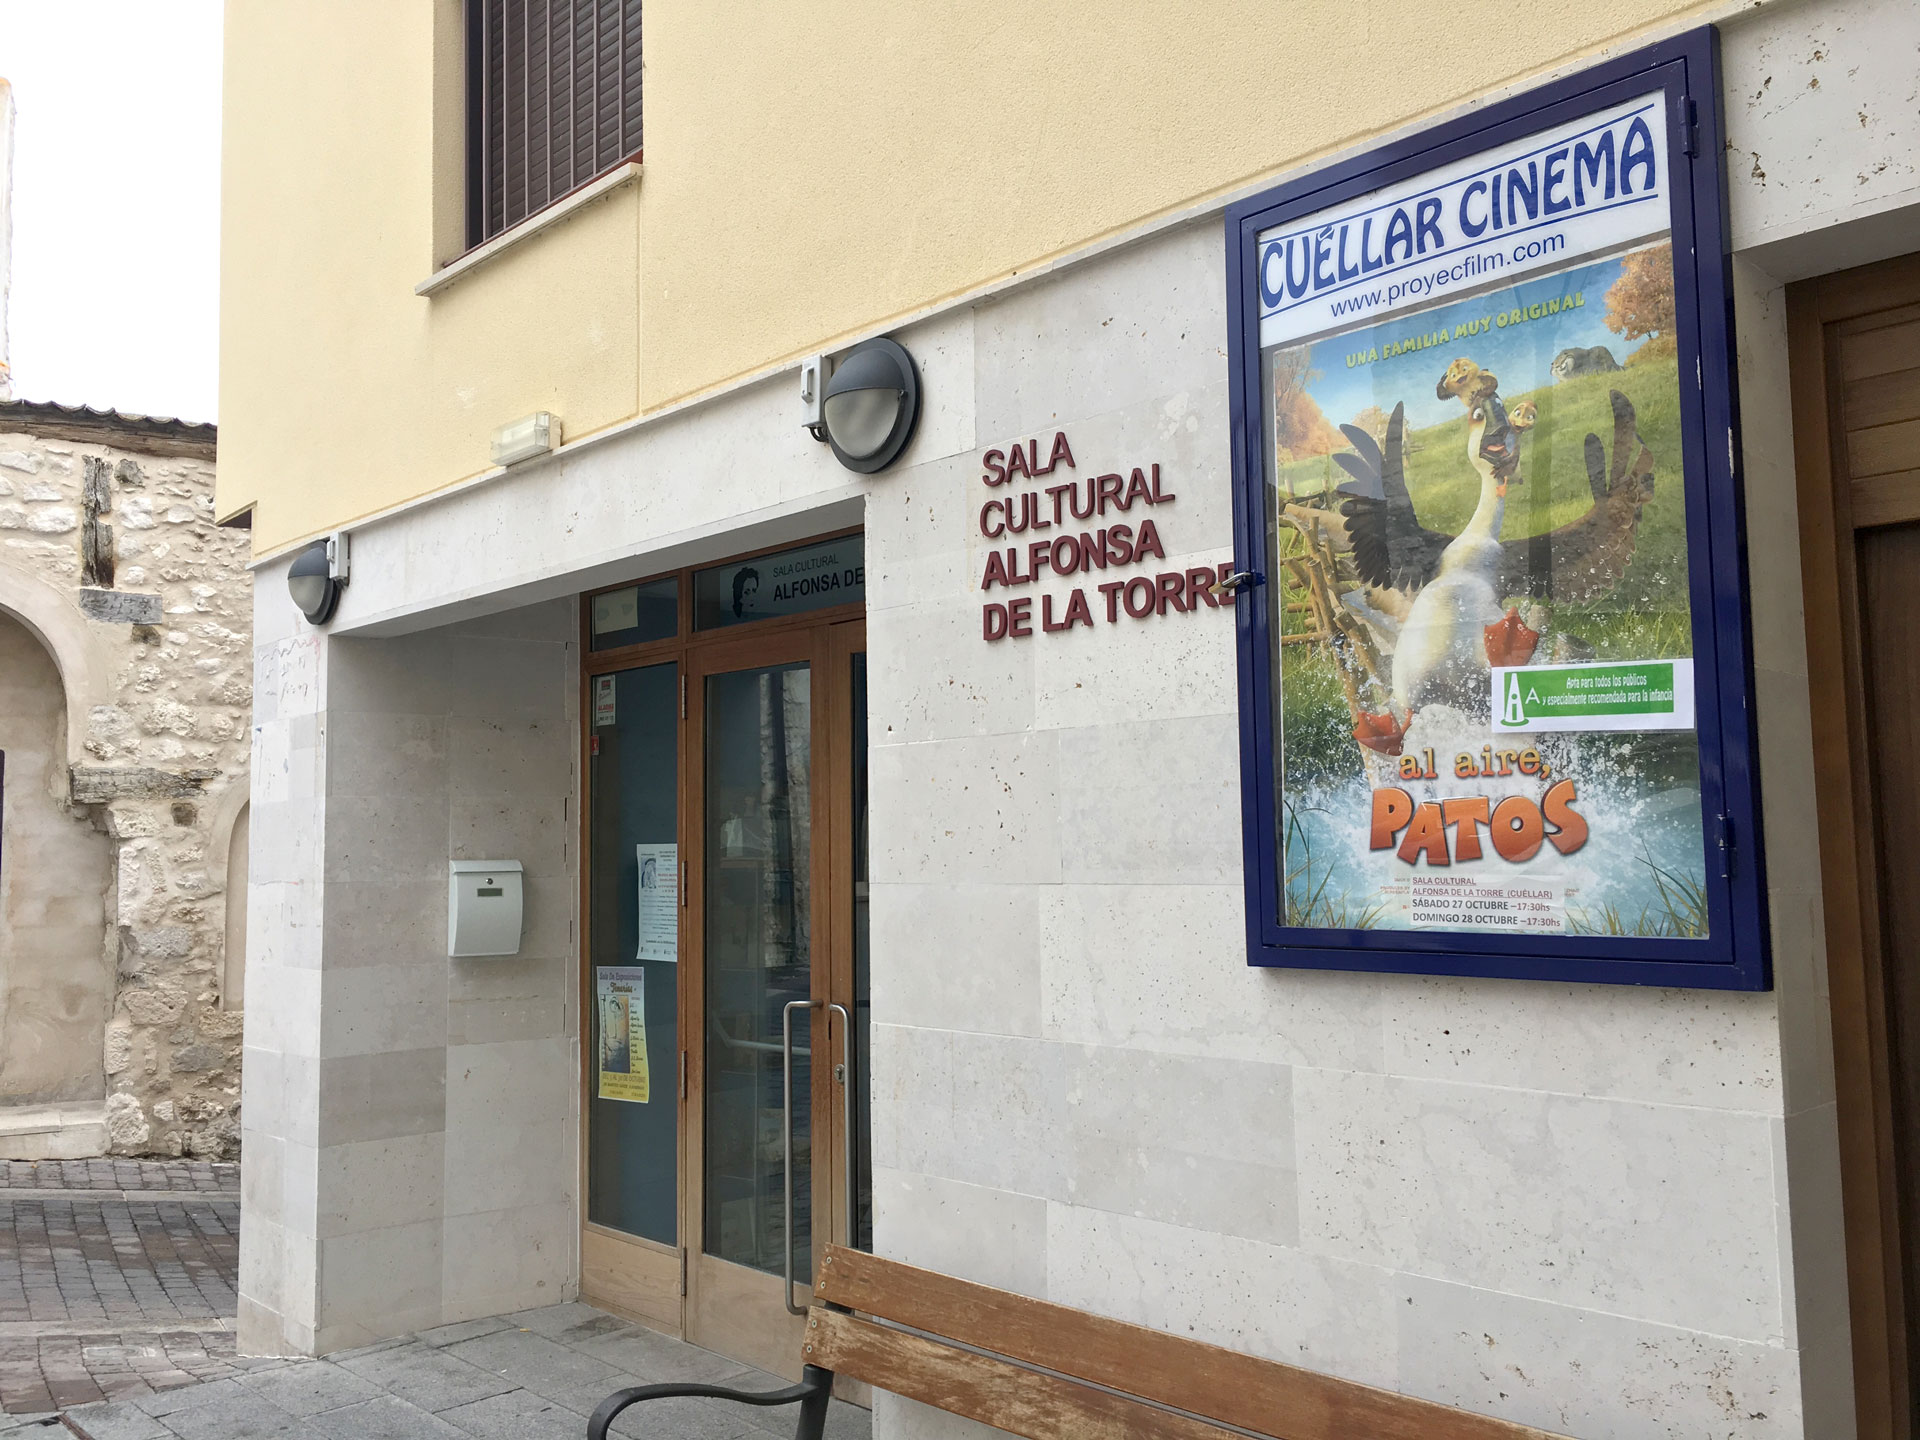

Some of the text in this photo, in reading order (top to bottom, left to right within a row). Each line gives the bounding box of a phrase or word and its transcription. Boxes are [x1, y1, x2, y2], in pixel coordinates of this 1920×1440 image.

[1260, 116, 1656, 309] CUÉLLAR CINEMA
[1330, 231, 1565, 318] www.proyecfilm.com
[1345, 292, 1586, 369] UNA FAMILIA MUY ORIGINAL
[982, 431, 1076, 488] SALA
[980, 463, 1176, 538] CULTURAL
[773, 553, 839, 578] SALA CULTURAL
[981, 519, 1166, 591] ALFONSA
[773, 572, 841, 601] ALFONSA
[983, 597, 1033, 641] DE
[1042, 588, 1094, 633] LA
[1525, 687, 1540, 705] A
[1547, 693, 1587, 706] especialmente
[1588, 690, 1627, 704] recomendada
[1628, 692, 1641, 703] para
[1642, 689, 1648, 702] la
[1649, 688, 1673, 701] infancia
[1566, 677, 1580, 689] Apta
[1595, 675, 1611, 688] todos
[1612, 674, 1621, 687] los
[1622, 673, 1647, 687] públicos
[1399, 744, 1552, 780] al aire,
[1370, 778, 1590, 867] PATOS
[1412, 877, 1433, 885] SALA
[1434, 877, 1476, 886] CULTURAL
[1412, 888, 1450, 896] ALFONSA
[1451, 888, 1461, 896] DE
[1476, 889, 1503, 897] TORRE
[1412, 897, 1450, 909] SÁBADO
[1452, 900, 1463, 909] 27
[1465, 900, 1508, 910] OCTUBRE
[1412, 913, 1460, 923] DOMINGO
[1462, 914, 1473, 924] 28
[1475, 915, 1518, 925] OCTUBRE
